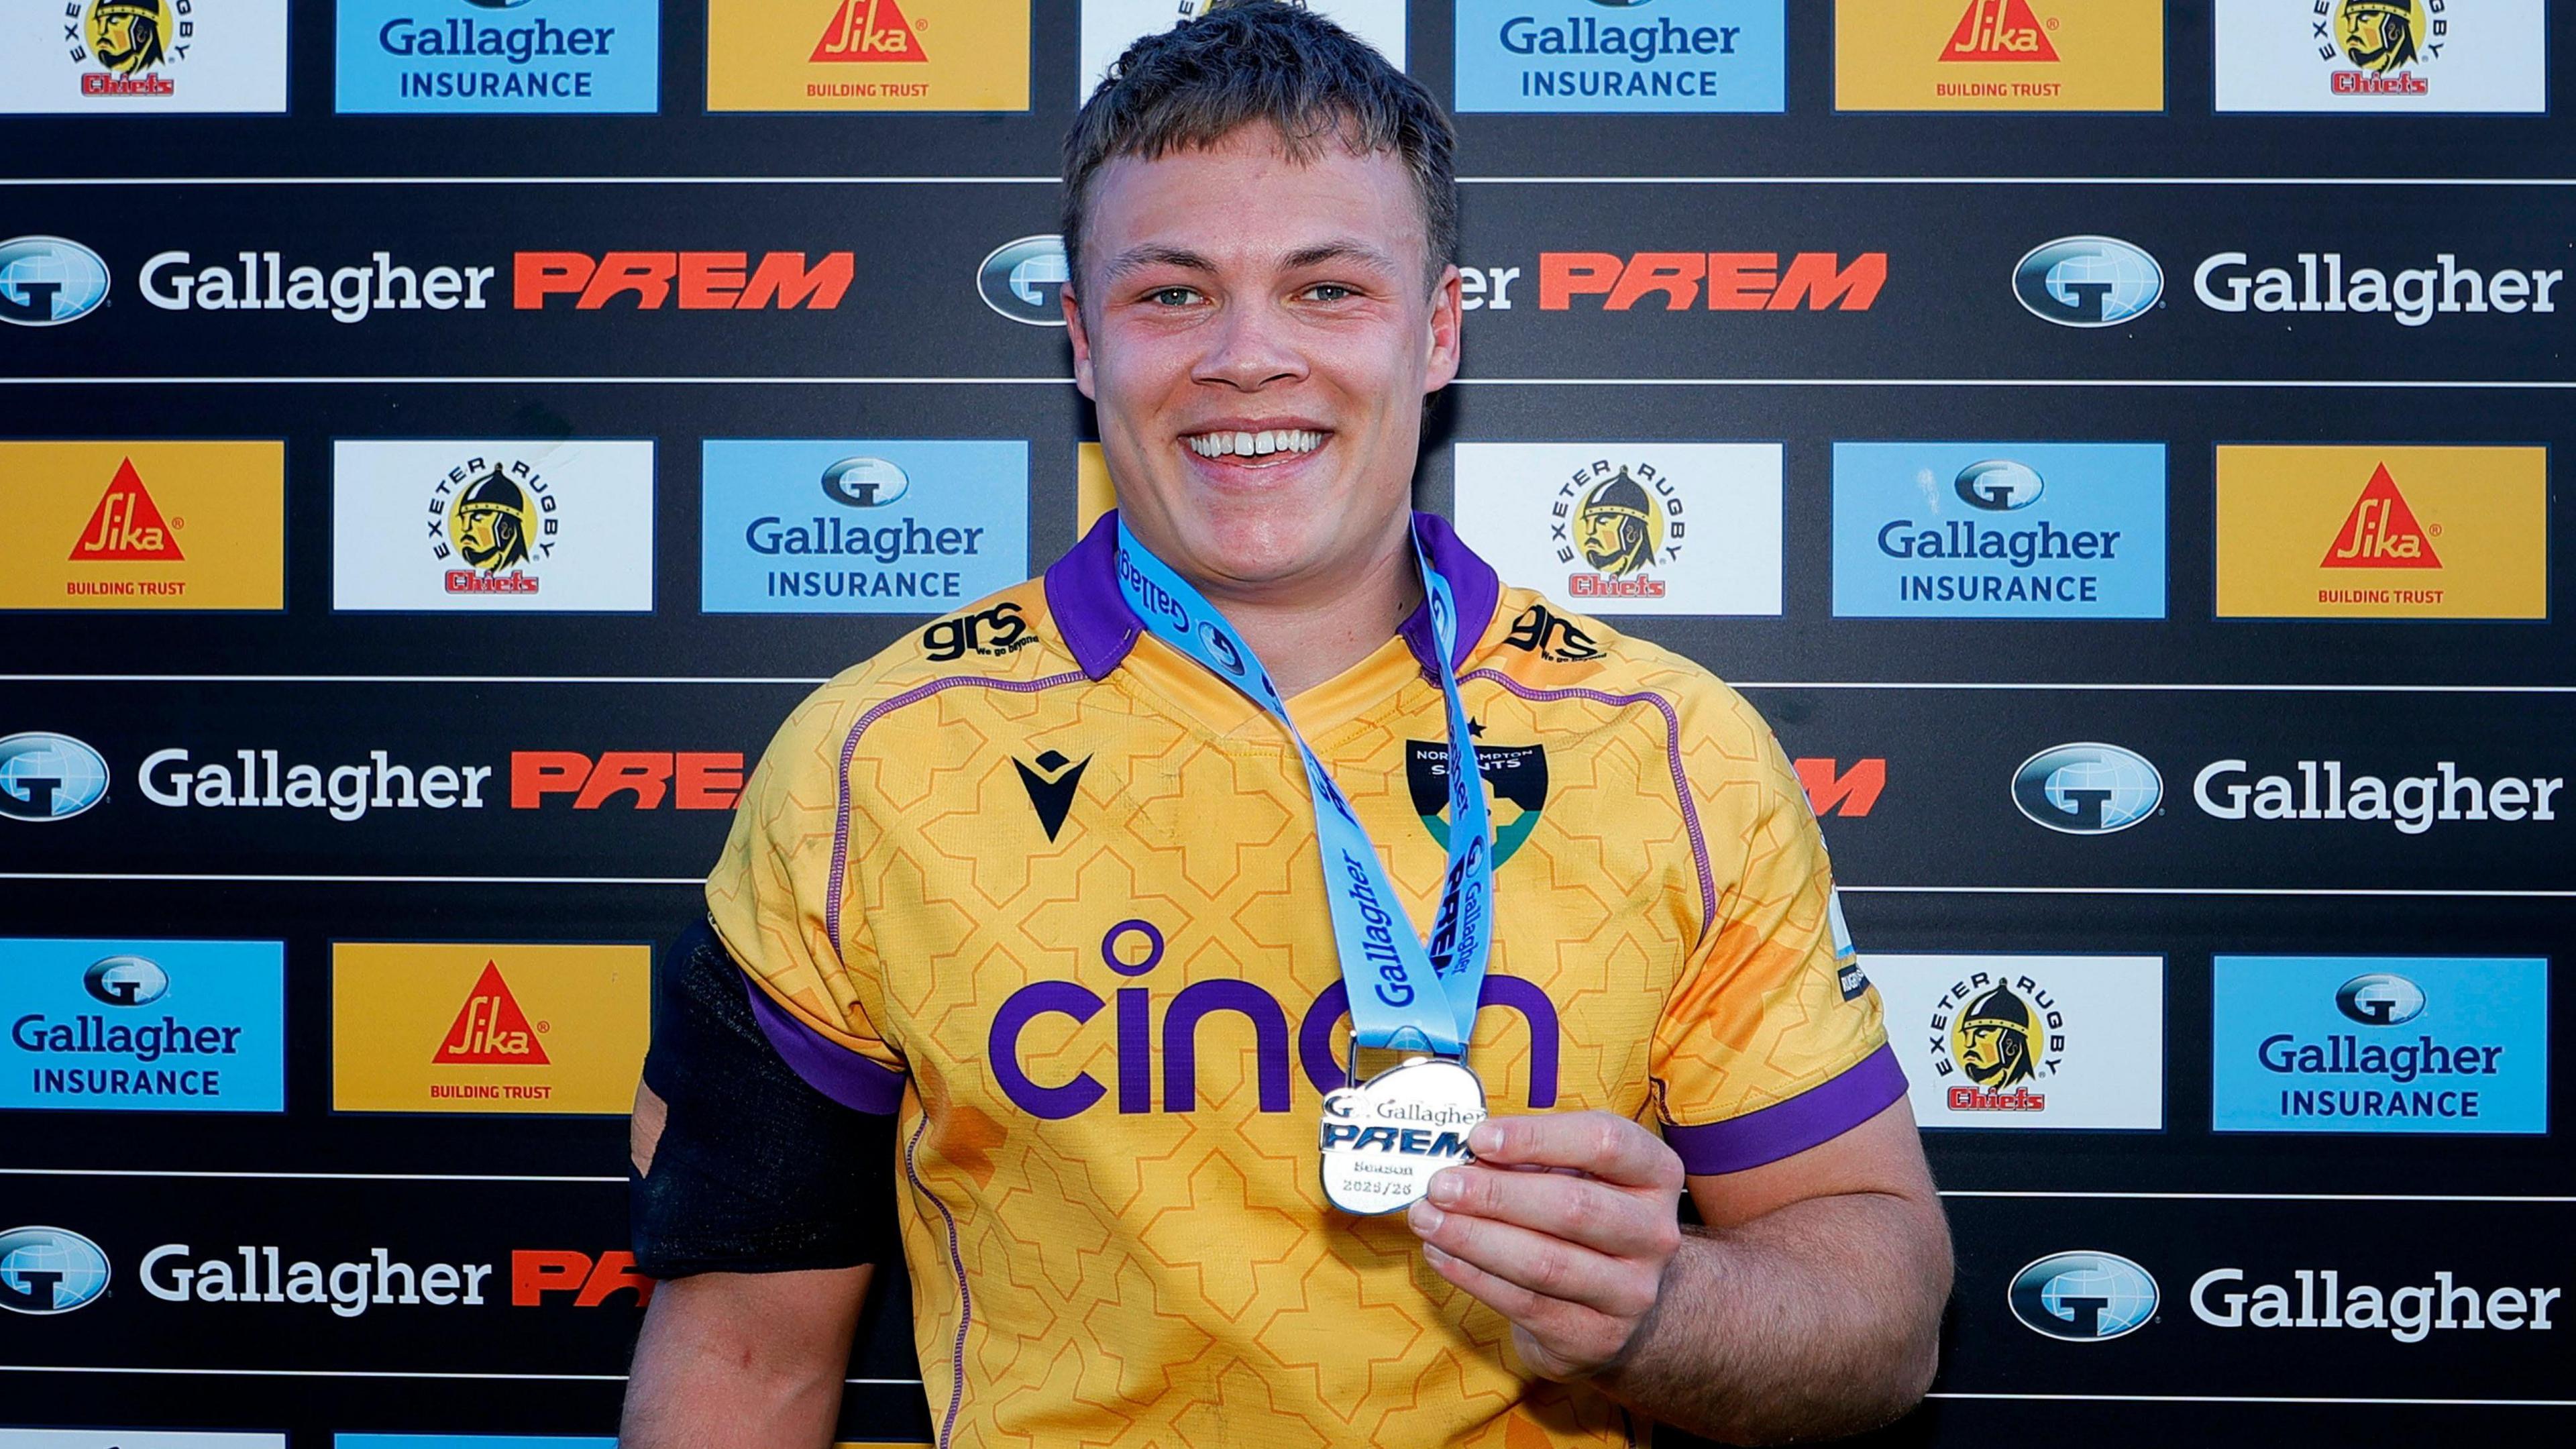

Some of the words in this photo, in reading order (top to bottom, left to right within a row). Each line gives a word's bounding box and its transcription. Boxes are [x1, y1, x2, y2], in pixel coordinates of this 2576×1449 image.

[380, 18, 614, 64] Gallagher
[825, 0, 908, 53] Sika
[1500, 17, 1739, 62] Gallagher
[1955, 0, 2039, 52] Sika
[81, 72, 174, 97] Chiefs
[402, 72, 590, 97] INSURANCE
[807, 84, 876, 97] BUILDING
[880, 84, 928, 97] TRUST
[1523, 72, 1716, 96] INSURANCE
[1937, 83, 2007, 96] BUILDING
[2012, 83, 2061, 96] TRUST
[2331, 70, 2428, 95] Chiefs
[139, 251, 494, 323] Gallagher
[513, 251, 855, 309] PREM
[1539, 252, 1887, 311] PREM
[2194, 252, 2563, 326] Gallagher
[85, 493, 164, 551] Sika
[428, 458, 486, 560] EXETER
[511, 460, 557, 558] RUGBY
[1551, 460, 1611, 564] EXETER
[1637, 463, 1685, 561] RUGBY
[2337, 498, 2421, 558] Sika
[747, 517, 983, 564] Gallagher
[1878, 521, 2120, 568] Gallagher
[67, 582, 134, 595] BUILDING
[138, 582, 185, 595] TRUST
[445, 570, 539, 594] Chiefs
[769, 572, 959, 596] INSURANCE
[1119, 549, 1189, 633] Gallag
[1569, 574, 1665, 598] Chiefs
[1902, 576, 2096, 601] INSURANCE
[2318, 590, 2390, 604] BUILDING
[2394, 590, 2444, 604] TRUST
[924, 602, 1026, 661] grs
[1502, 604, 1597, 658] grs
[1417, 749, 1534, 761] NORMPTON
[1431, 759, 1521, 775] SNTS
[138, 748, 491, 821] Gallagher
[511, 751, 748, 810] PRE
[2194, 759, 2563, 834] Gallagher
[1342, 847, 1415, 1008] Gallagher
[1452, 882, 1483, 975] Gallagher
[12, 1014, 241, 1061] Gallagher
[448, 996, 529, 1054] Sika
[1929, 972, 1990, 1077] EXETER
[2017, 975, 2065, 1075] RUGBY
[34, 1069, 219, 1095] INSURANCE
[2259, 1034, 2502, 1083] Gallagher
[431, 1085, 500, 1099] BUILDING
[502, 1085, 551, 1099] TRUST
[1377, 1099, 1487, 1126] Gallagher
[1947, 1086, 2045, 1111] Chiefs
[2282, 1091, 2479, 1118] INSURANCE
[140, 1244, 492, 1317] Gallagher
[512, 1250, 657, 1307] PR
[2190, 1268, 2561, 1343] Gallagher
